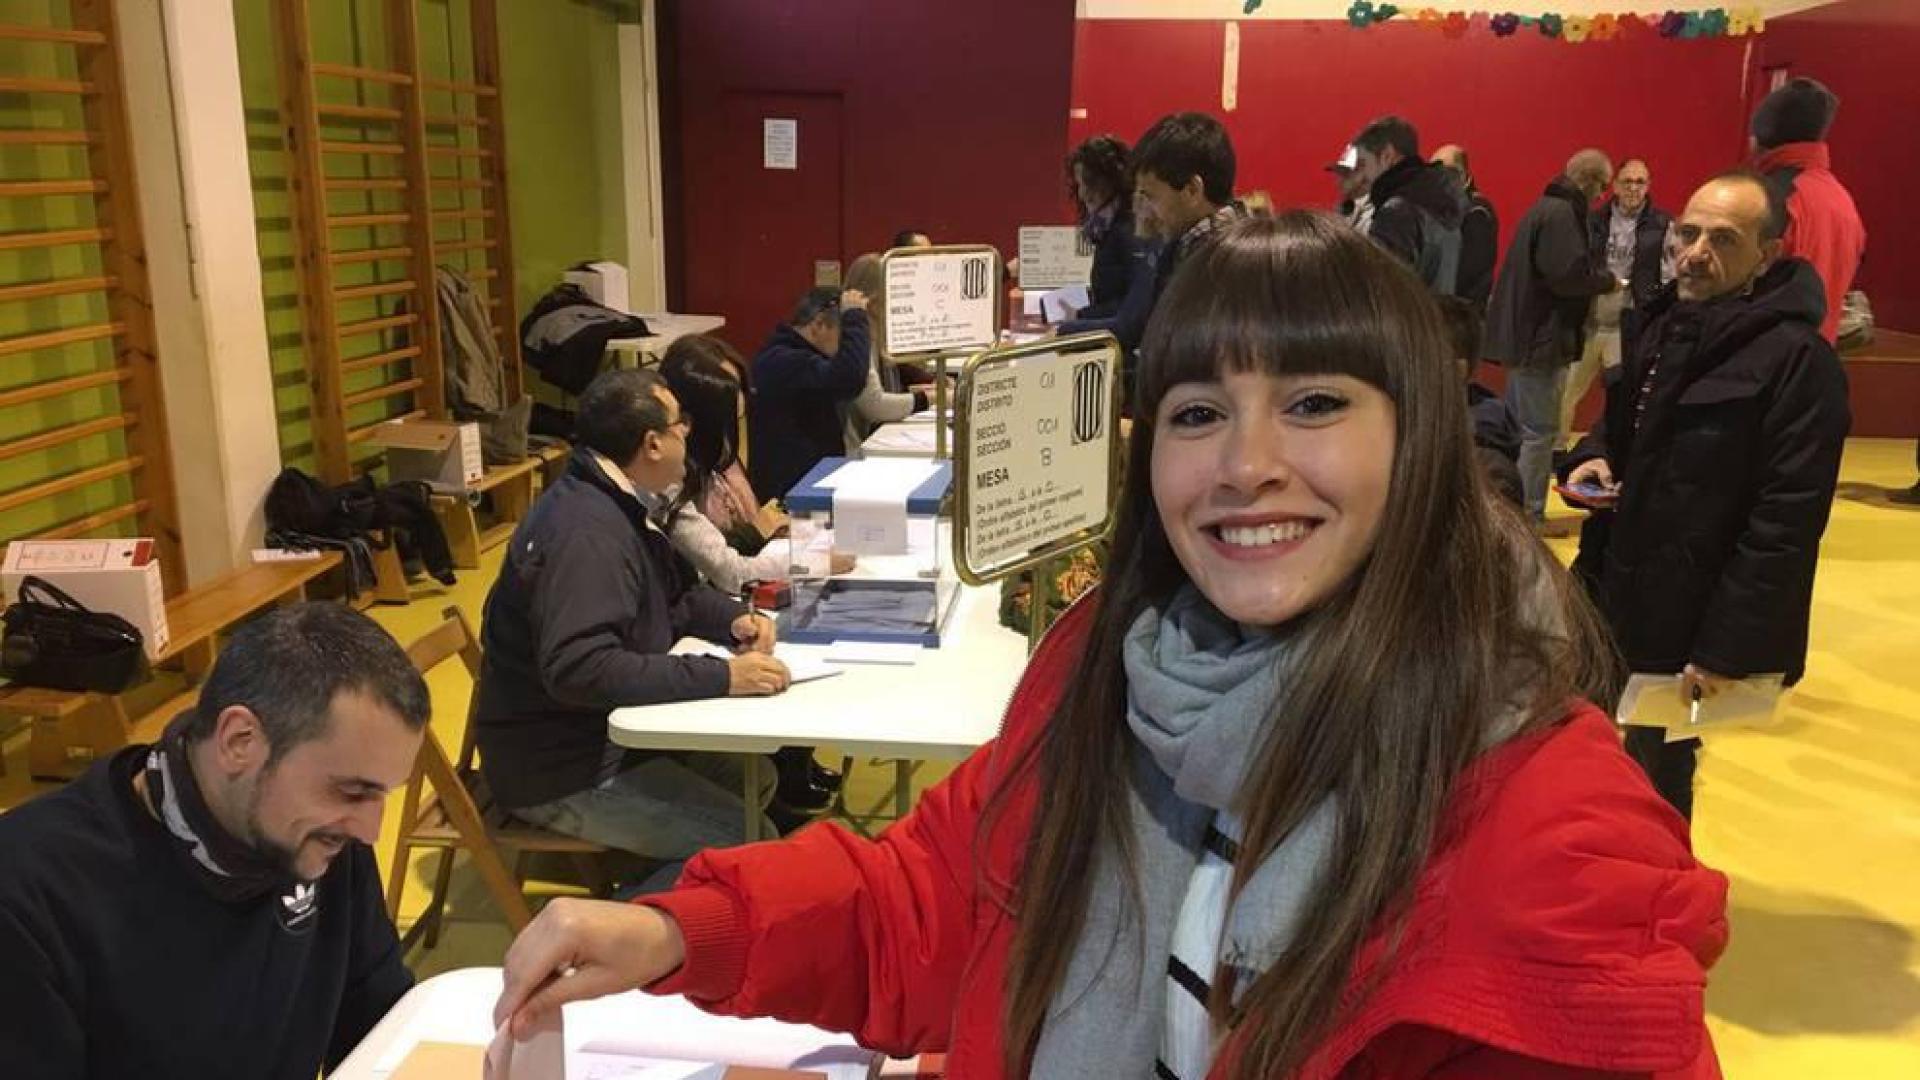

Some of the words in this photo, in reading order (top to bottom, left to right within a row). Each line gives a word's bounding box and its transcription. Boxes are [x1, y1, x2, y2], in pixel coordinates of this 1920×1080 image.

[978, 377, 1016, 394] DISTRICTE
[976, 395, 1013, 411] DISTRITO
[977, 467, 1009, 489] MESA
